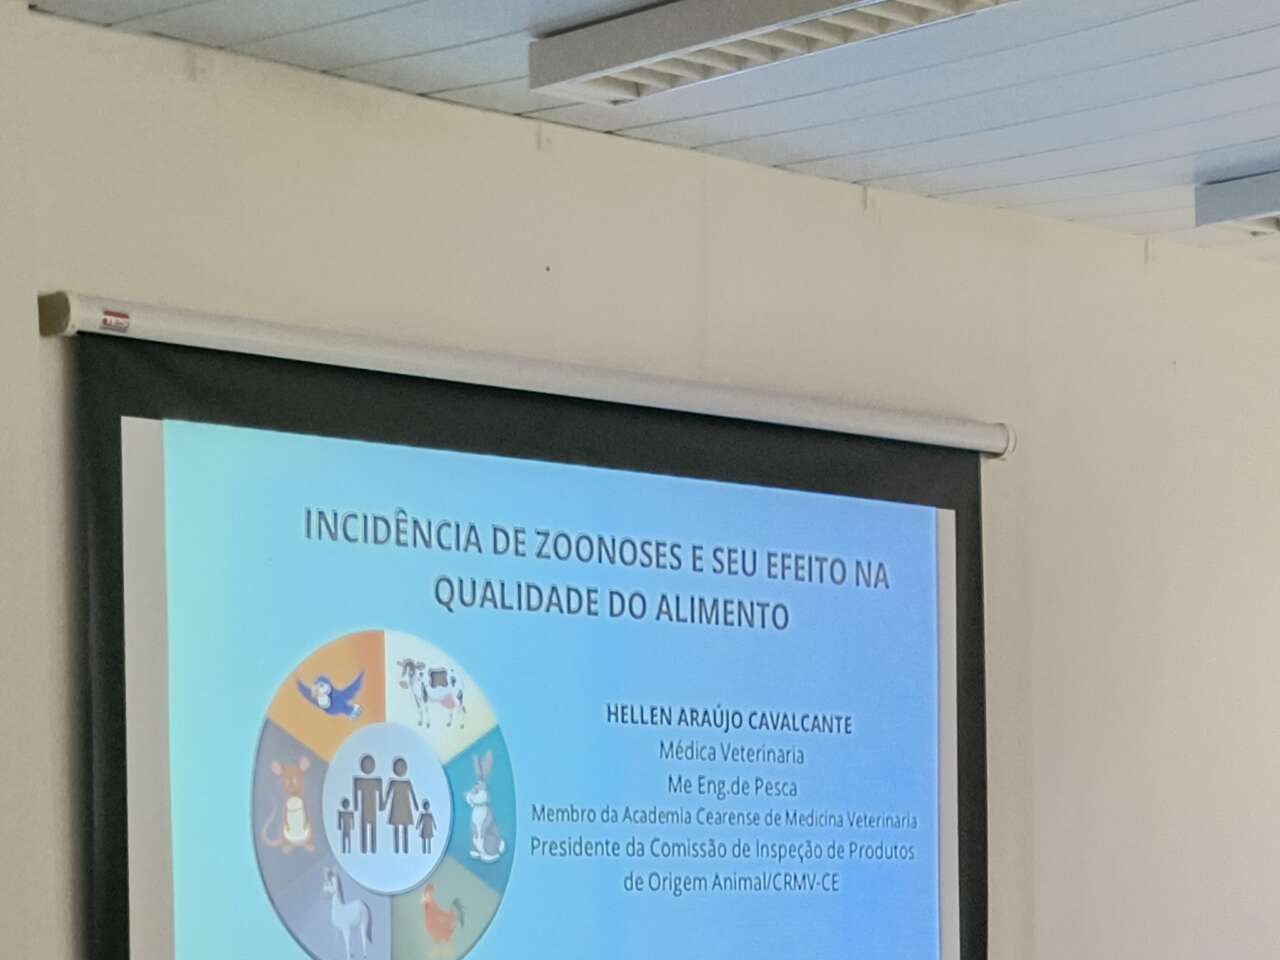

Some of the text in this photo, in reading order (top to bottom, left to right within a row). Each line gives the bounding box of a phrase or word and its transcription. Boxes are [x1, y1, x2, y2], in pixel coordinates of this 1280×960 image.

[304, 506, 890, 590] INCIDÊNCIA DE ZOONOSES E SEU EFEITO NA
[434, 574, 789, 631] QUALIDADE DO ALIMENTO
[606, 703, 853, 735] HELLEN ARAÚJO CAVALCANTE
[659, 739, 717, 762] Médica
[668, 774, 693, 794] Me
[755, 777, 798, 797] Pesca
[531, 804, 597, 823] Membro
[601, 805, 618, 824] da
[622, 805, 692, 825] Academia
[696, 807, 761, 826] Cearense
[764, 808, 782, 827] de
[785, 809, 844, 828] Medicina
[531, 836, 915, 863] Presidente da Comissão de Inspeção de Produtos
[624, 871, 840, 897] de Origem Animal/CRMV-CE
